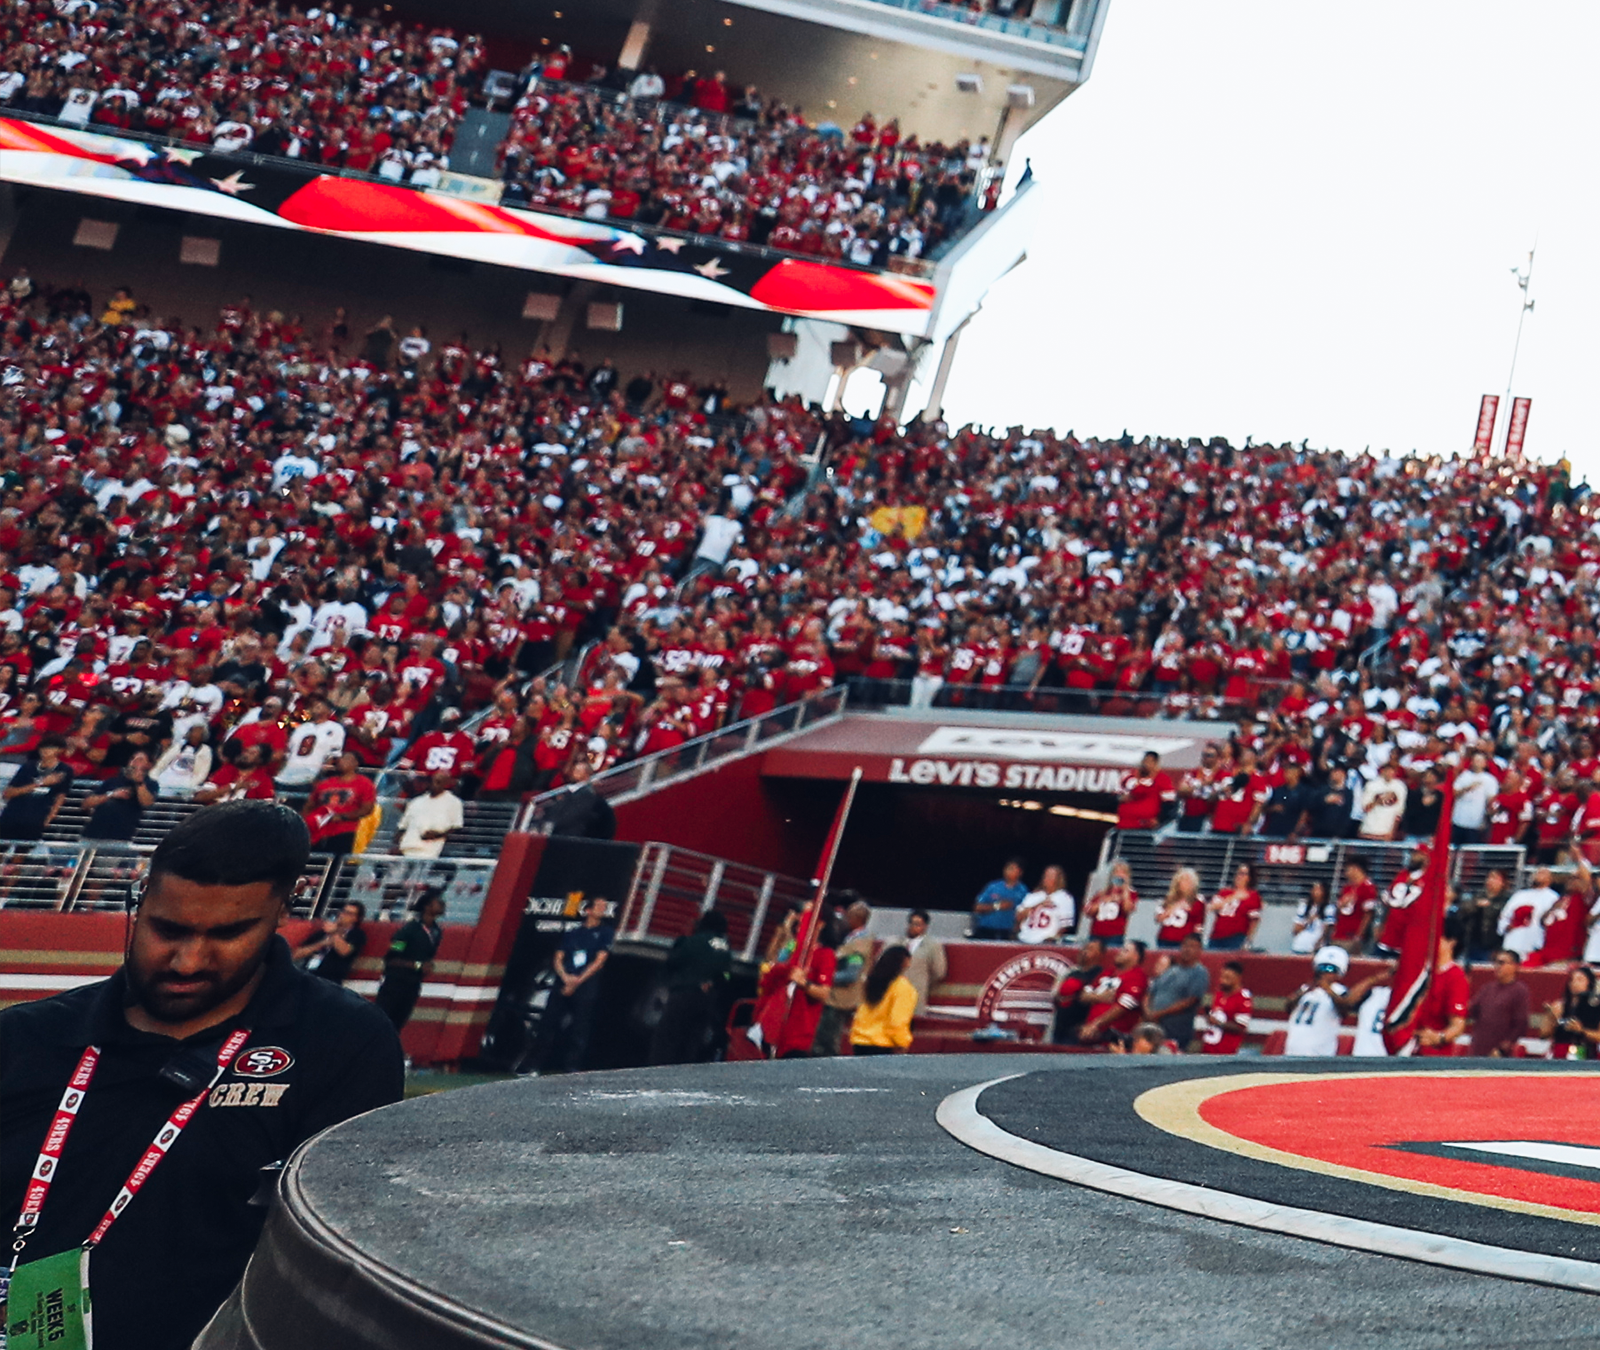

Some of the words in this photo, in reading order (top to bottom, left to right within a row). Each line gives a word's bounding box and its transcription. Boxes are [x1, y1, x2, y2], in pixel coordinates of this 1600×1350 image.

[247, 1050, 282, 1073] SF
[209, 1081, 291, 1108] CREW
[45, 1116, 71, 1152] 49ERS
[130, 1150, 162, 1188] 49ERS
[46, 1287, 65, 1333] WEEK
[48, 1329, 65, 1342] 5
